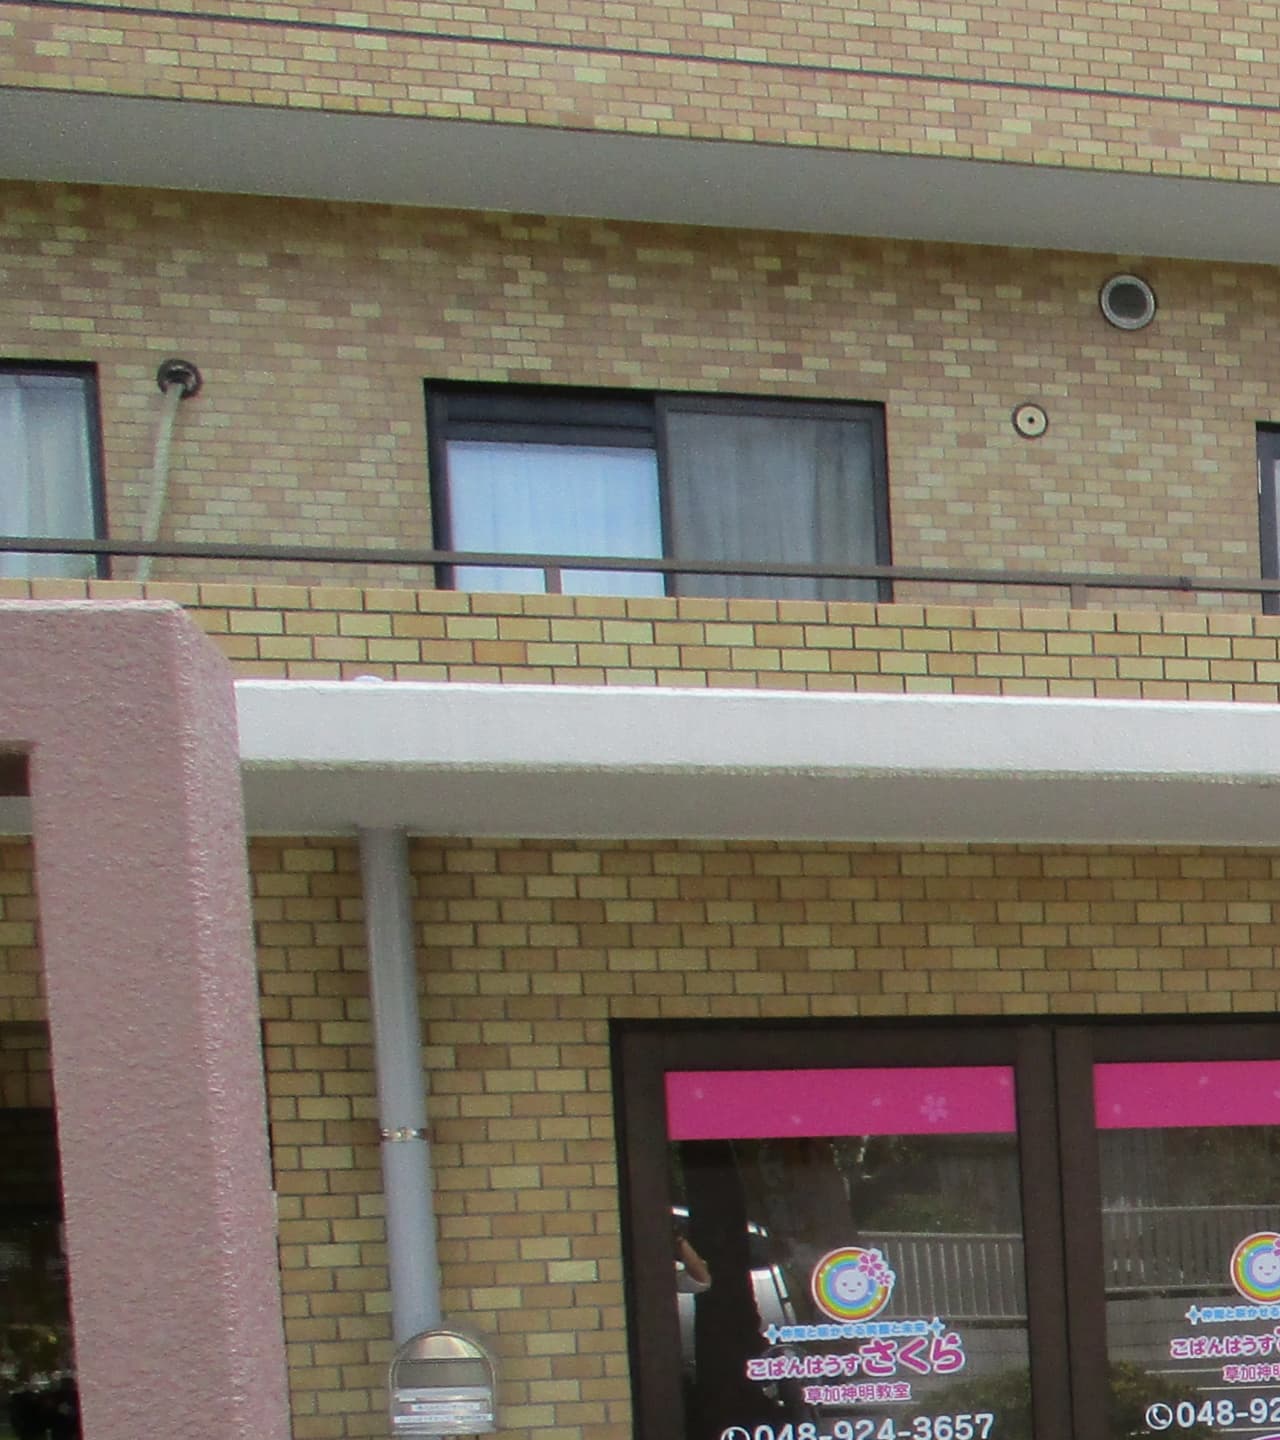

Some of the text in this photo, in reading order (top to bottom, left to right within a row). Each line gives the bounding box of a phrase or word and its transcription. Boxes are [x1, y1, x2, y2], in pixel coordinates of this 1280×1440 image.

[802, 1381, 912, 1404] 草加神明教室
